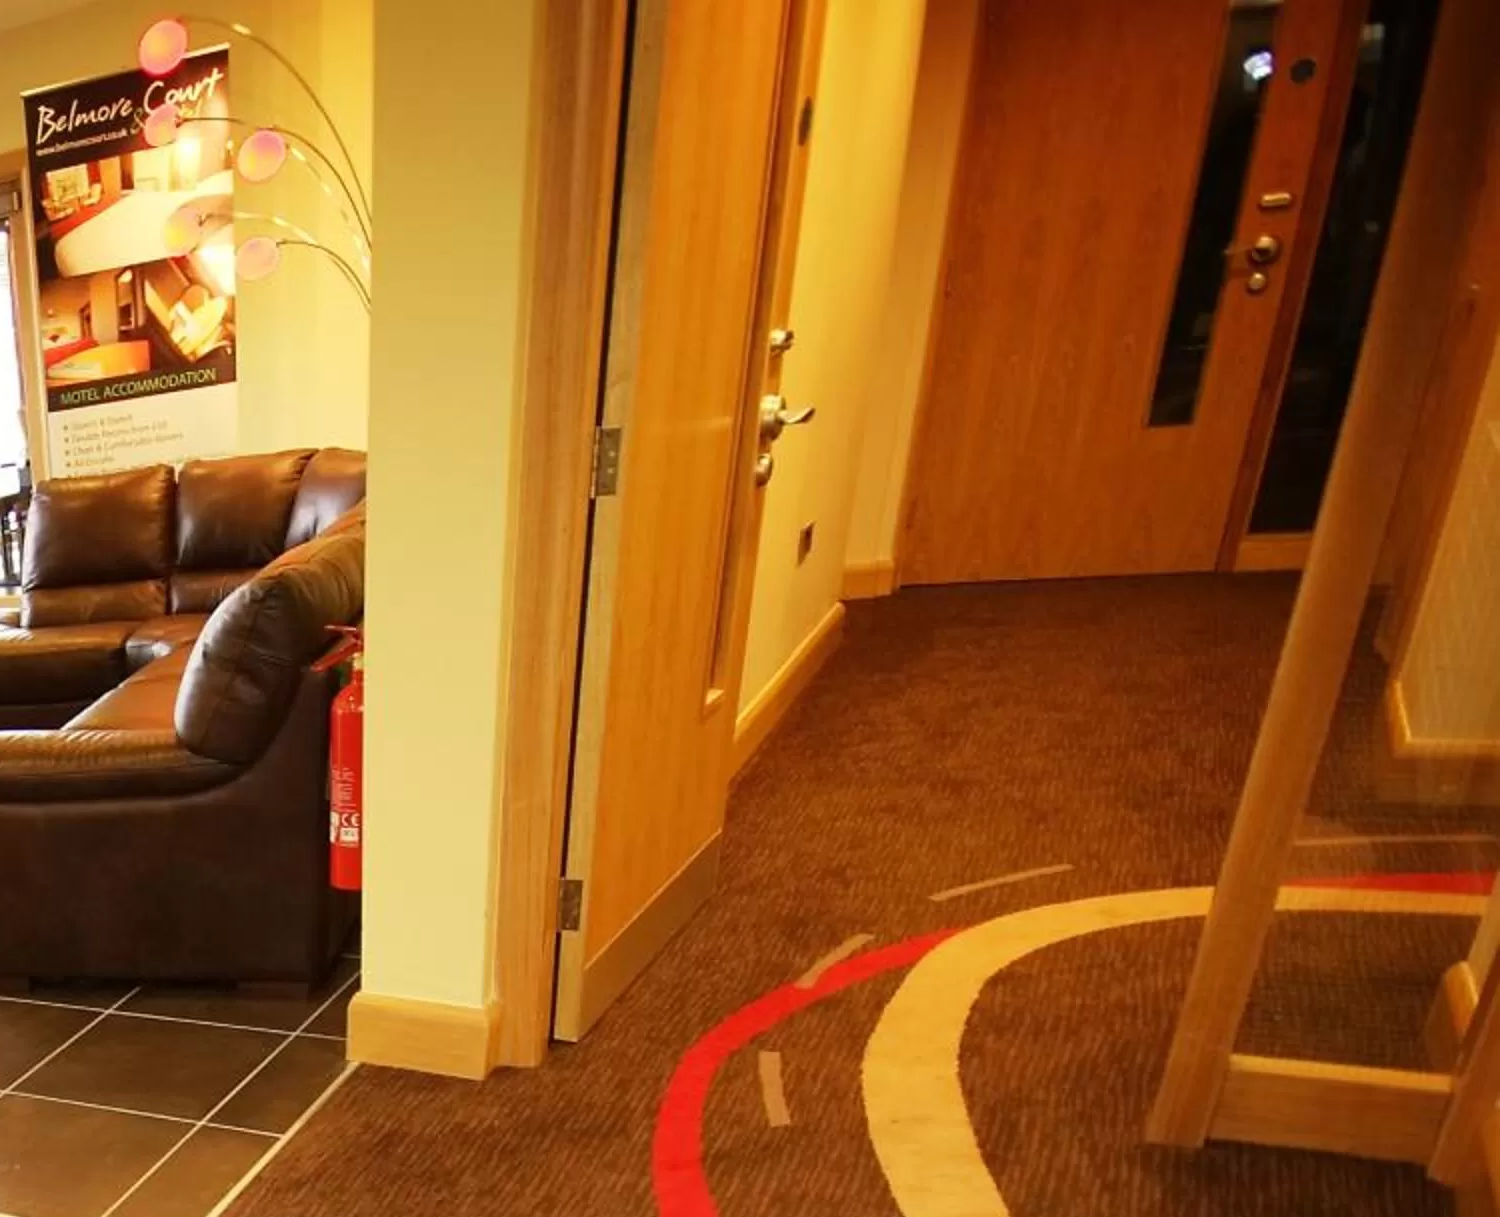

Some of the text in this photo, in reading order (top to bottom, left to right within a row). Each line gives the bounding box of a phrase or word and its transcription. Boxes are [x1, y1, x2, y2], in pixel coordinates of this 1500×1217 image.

[36, 67, 224, 145] Belmore Court
[60, 367, 218, 405] MOTEL ACCOMMODATION
